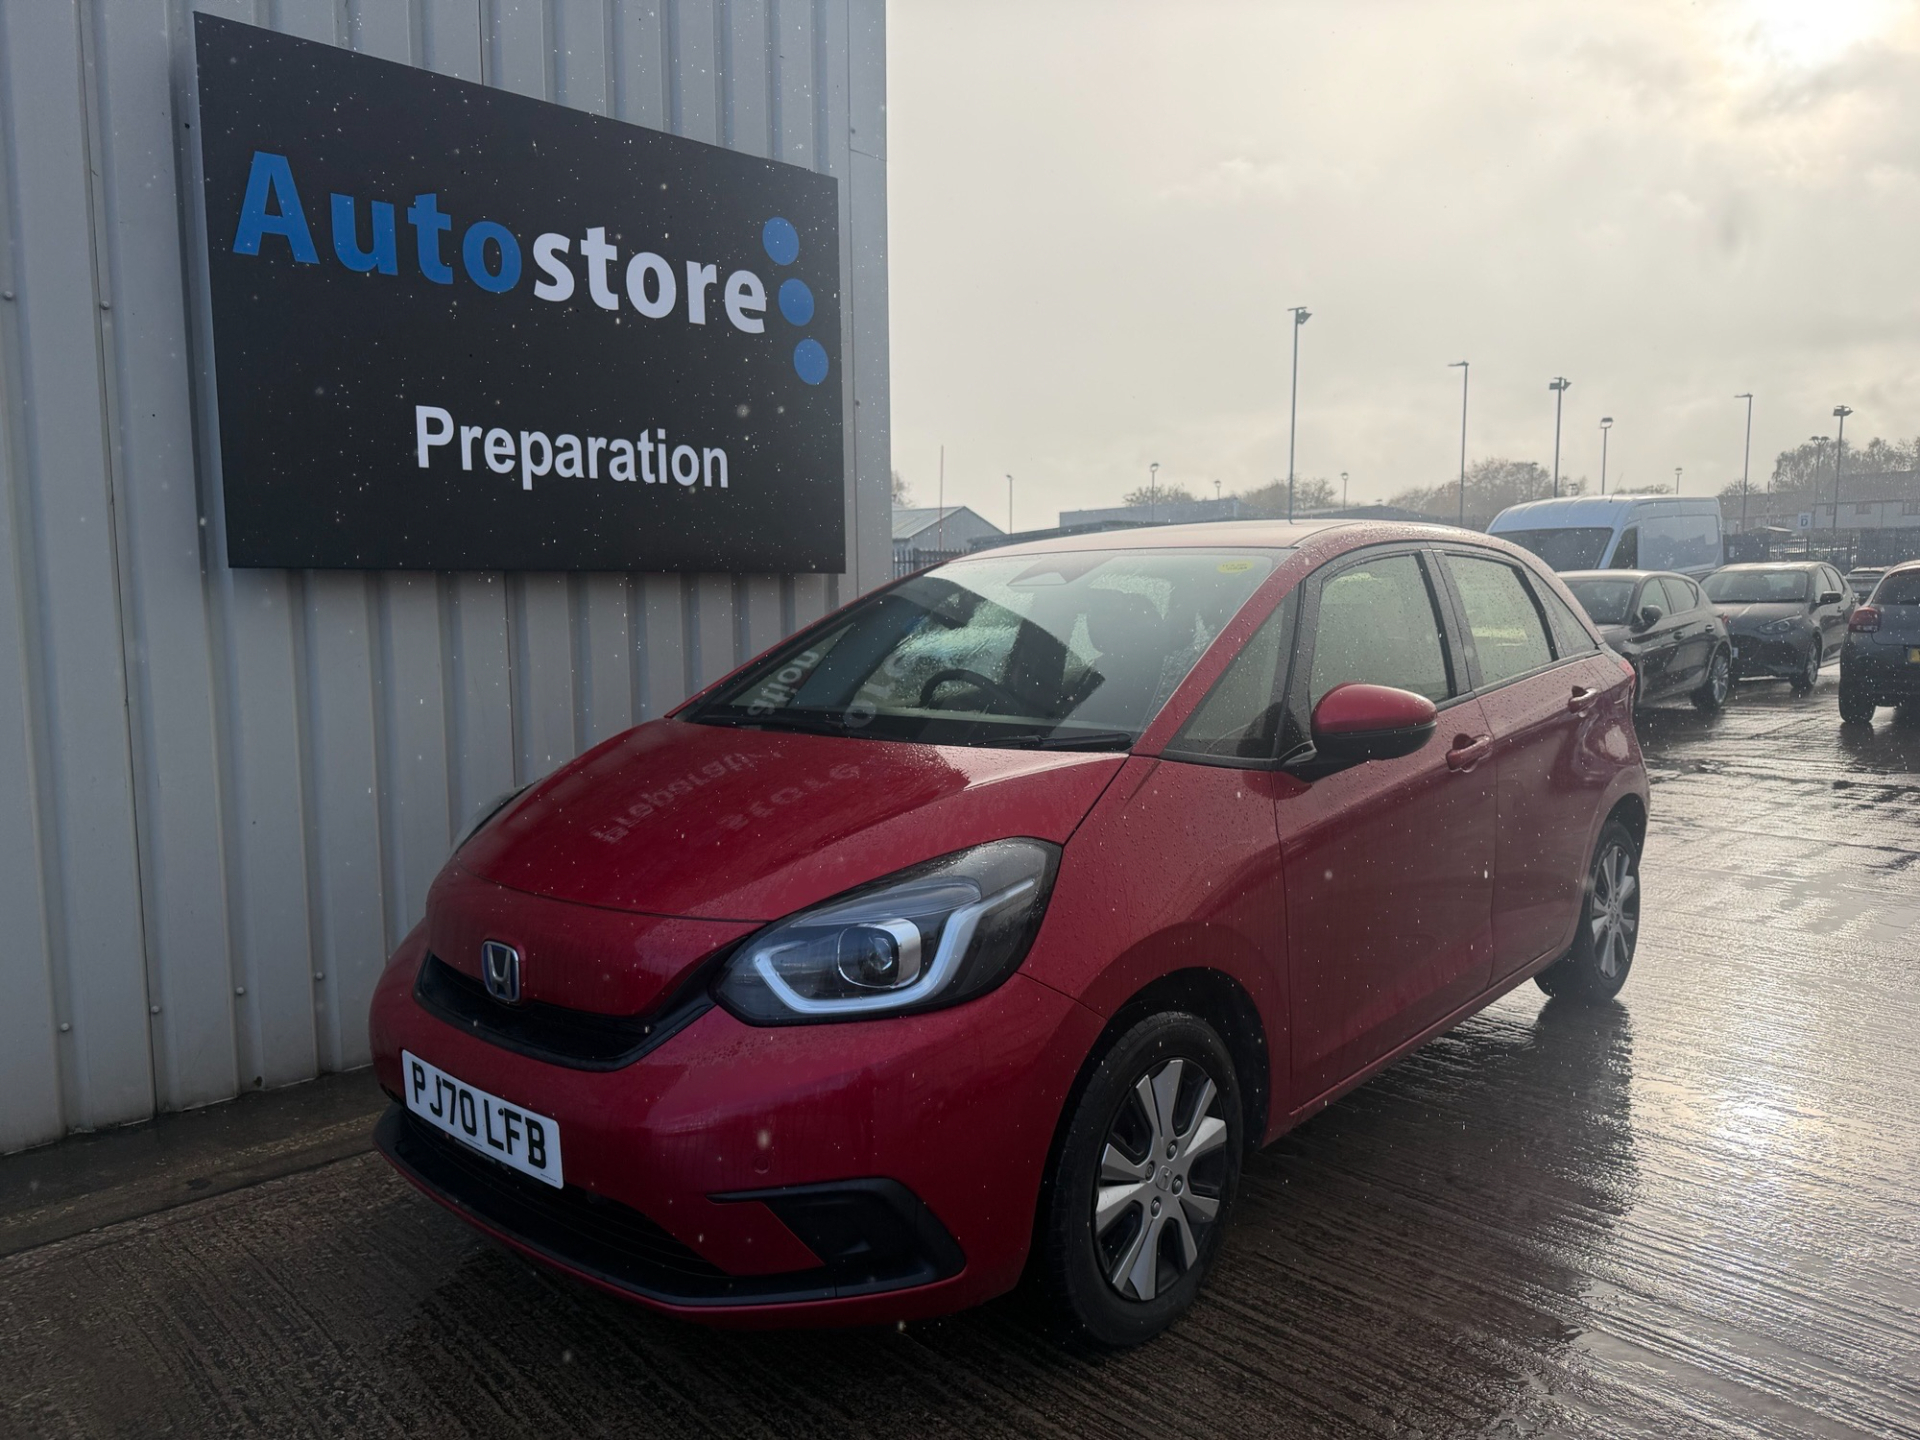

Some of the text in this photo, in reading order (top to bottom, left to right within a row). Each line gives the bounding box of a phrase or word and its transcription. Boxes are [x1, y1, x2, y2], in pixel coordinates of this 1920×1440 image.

[233, 151, 767, 334] Autostore
[415, 405, 729, 491] Preparation
[411, 1060, 547, 1170] PJ70 LFB
